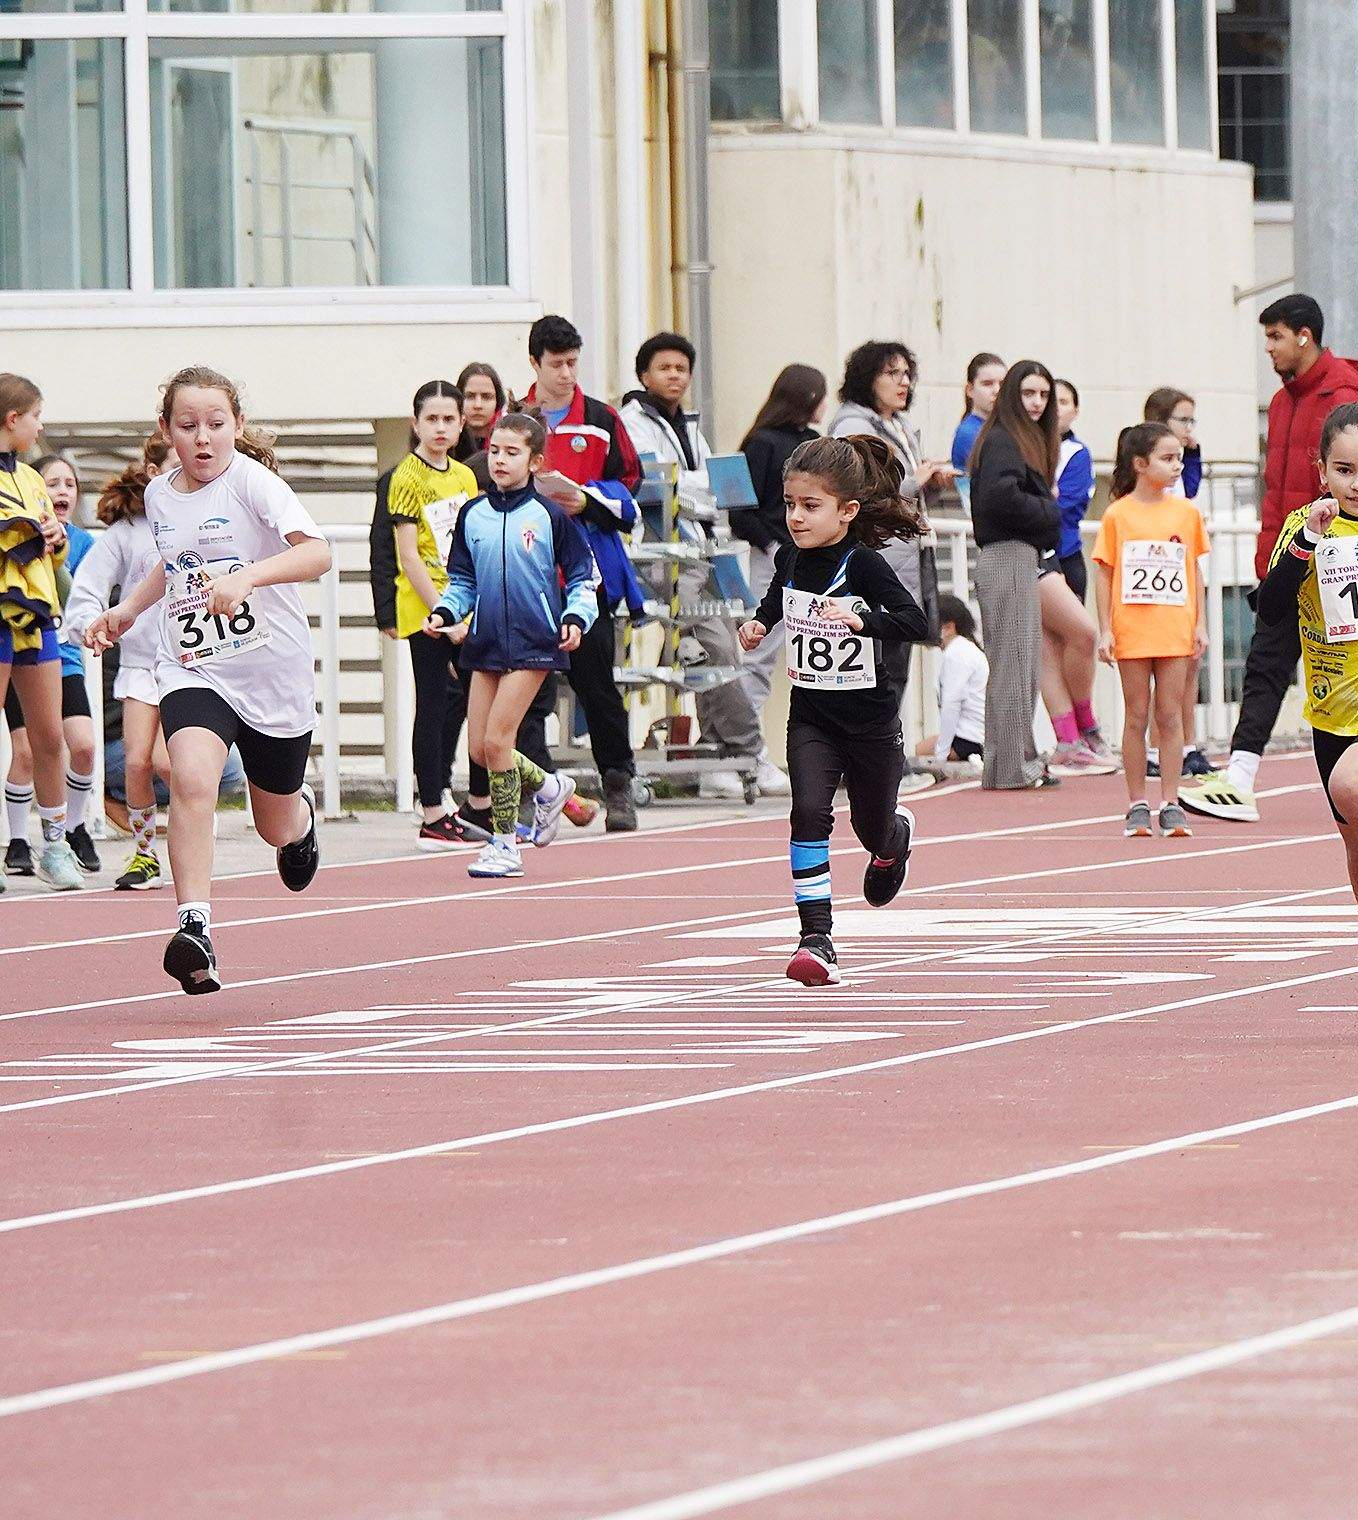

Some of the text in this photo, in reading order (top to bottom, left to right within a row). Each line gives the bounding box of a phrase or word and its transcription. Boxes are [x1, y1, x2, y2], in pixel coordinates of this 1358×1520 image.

[1324, 568, 1337, 576] VII
[1132, 568, 1183, 593] 266
[1320, 575, 1344, 585] GRAN
[181, 601, 207, 614] PREMIO
[177, 600, 256, 649] 318
[792, 617, 818, 628] TORNEO
[796, 627, 821, 636] PREMIO
[791, 633, 864, 672] 182
